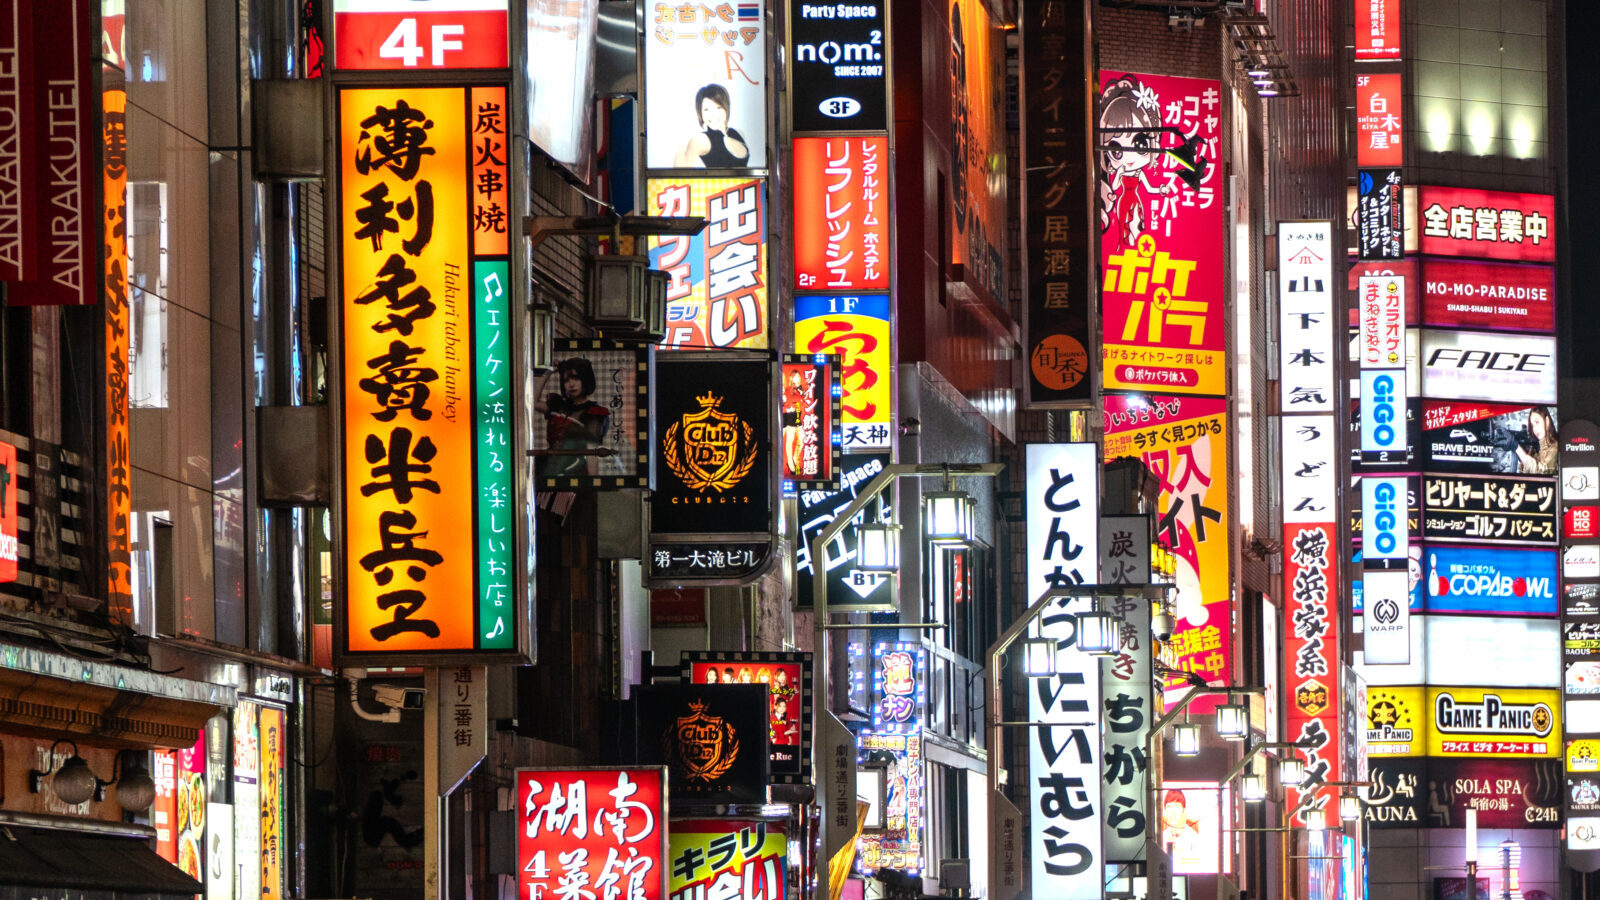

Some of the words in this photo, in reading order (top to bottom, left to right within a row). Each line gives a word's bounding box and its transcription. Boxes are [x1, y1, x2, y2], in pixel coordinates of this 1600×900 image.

[802, 5, 834, 19] Party
[837, 4, 876, 19] Space
[379, 18, 465, 67] 4F
[835, 66, 859, 76] SINCE
[861, 65, 882, 76] 2007
[1357, 77, 1370, 86] 5F
[829, 101, 850, 115] 3F
[1182, 96, 1200, 206] コンェ
[473, 102, 506, 234] 炭火串焼
[1387, 171, 1401, 185] 4F
[49, 80, 82, 291] ANRAKUTEI
[862, 141, 879, 225] レンタルルーム
[825, 140, 854, 287] リフレッシュ
[1369, 198, 1380, 249] &コミック
[1379, 185, 1391, 256] インターネット
[1424, 204, 1547, 245] 全店営業中
[709, 185, 759, 348] 出会い
[863, 232, 880, 280] ホステル
[1103, 234, 1197, 297] ポケ
[443, 263, 460, 317] Hakuri
[799, 274, 816, 286] 2F
[1426, 282, 1547, 301] MO-MO-PARADISE
[667, 305, 699, 321] ラリ
[828, 297, 859, 312] 1F
[1447, 304, 1493, 314] SHABU-SHABU
[1365, 282, 1381, 363] まねきねこ
[1386, 295, 1400, 350] カラオケ
[444, 322, 461, 361] tabai
[1034, 343, 1085, 384] 旬香
[1426, 348, 1550, 373] FACE
[441, 366, 462, 423] hanbey
[1424, 406, 1451, 419] インドア
[688, 424, 736, 443] Club
[844, 425, 888, 446] 天神
[1133, 419, 1222, 449] 今すぐ見つかる
[1380, 452, 1388, 461] 2
[1432, 443, 1464, 454] BRAVE
[1465, 444, 1494, 455] POINT
[801, 490, 839, 508] Par
[1426, 480, 1554, 512] ビリヤード&ダーツ
[1573, 510, 1590, 518] MO
[1573, 520, 1590, 529] MO
[1510, 520, 1553, 538] バグース
[655, 550, 760, 568] 第一大滝ビル
[1382, 559, 1389, 568] 1
[853, 573, 876, 586] B1
[1290, 527, 1329, 679] 横浜家系
[1439, 696, 1482, 729] GAME
[1486, 697, 1531, 729] PANIC
[1384, 726, 1411, 740] PANIC
[1104, 692, 1146, 839] ちから
[1455, 779, 1491, 795] SOLA
[1496, 779, 1522, 795] SPA
[526, 771, 654, 845] 湖南
[1364, 806, 1418, 821] AUNA
[673, 822, 767, 881] キラリ
